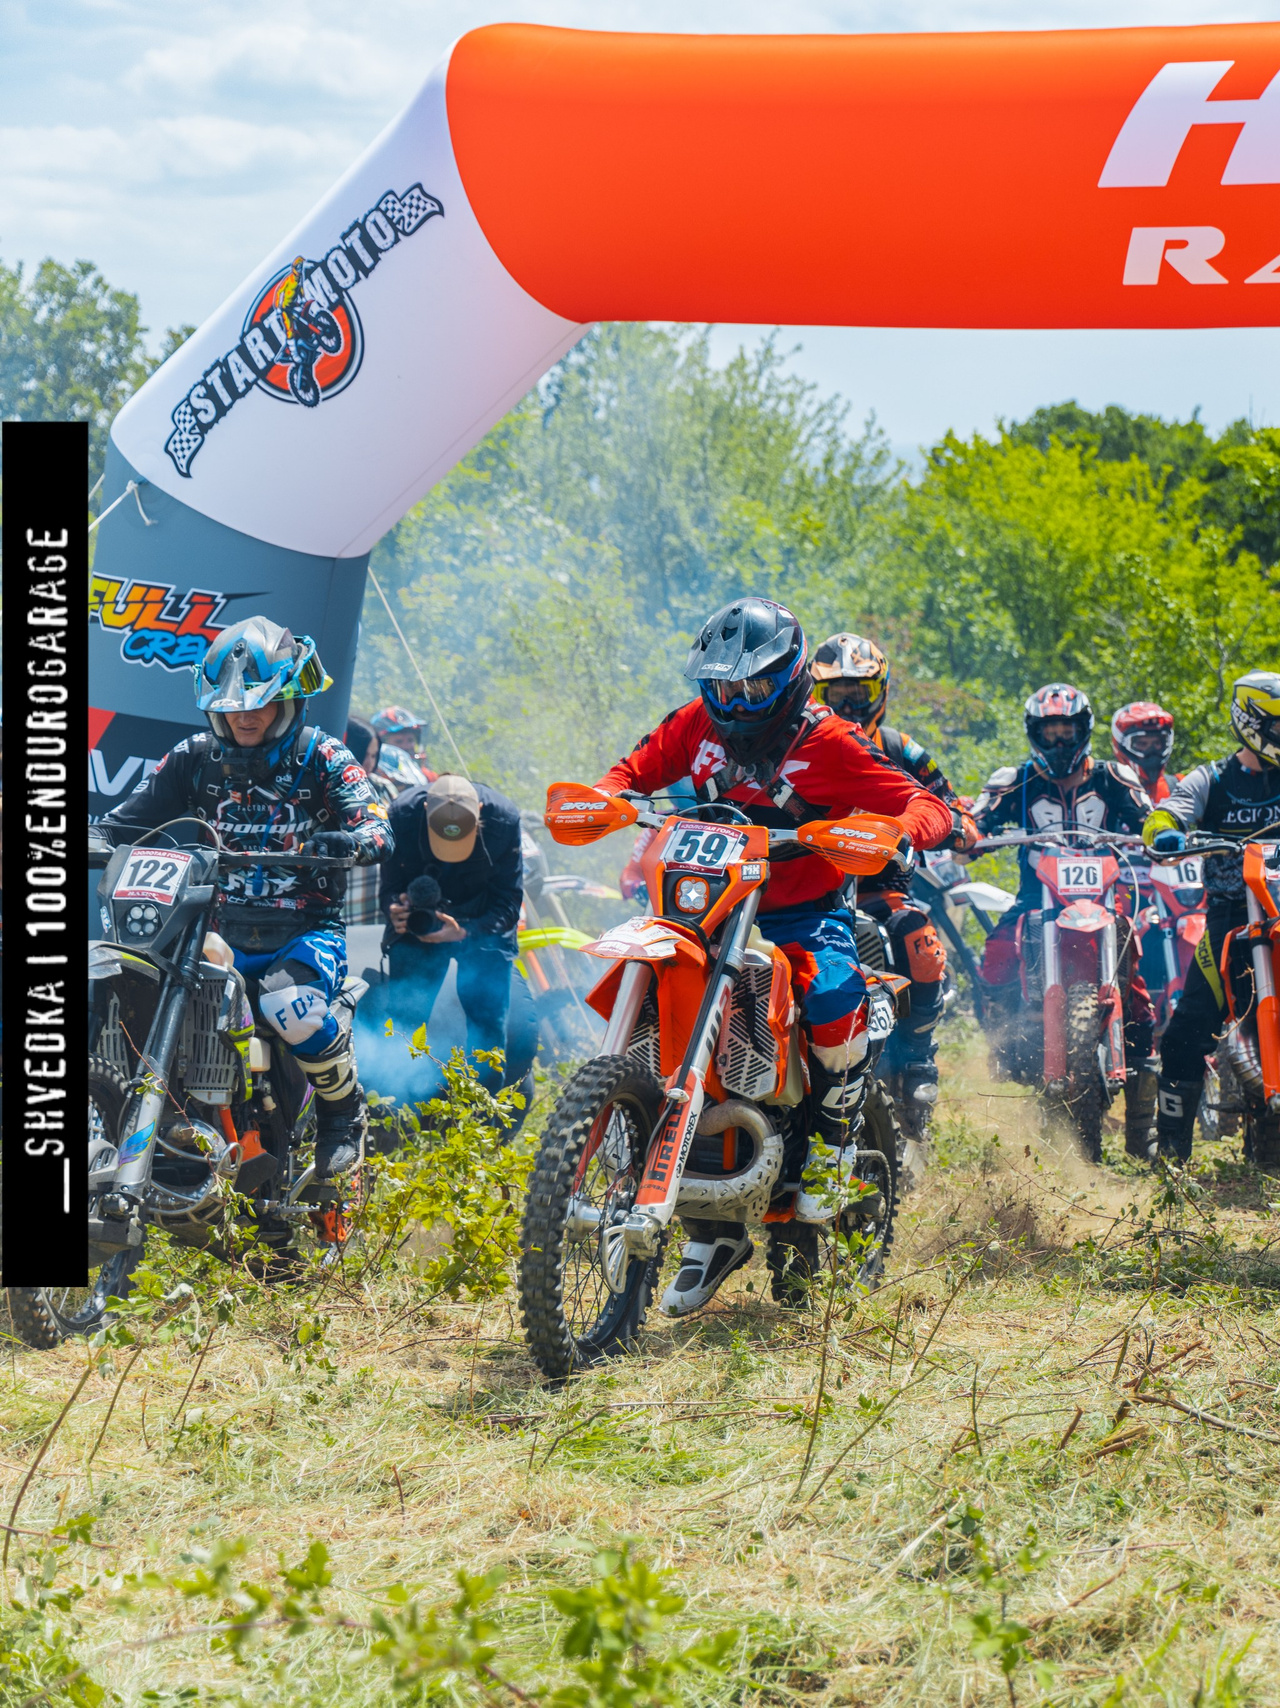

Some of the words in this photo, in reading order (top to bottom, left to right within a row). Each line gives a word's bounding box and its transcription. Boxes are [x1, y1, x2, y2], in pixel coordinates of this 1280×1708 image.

[189, 311, 287, 425] START
[303, 209, 398, 317] MOTO
[88, 574, 224, 641] FULL
[124, 628, 210, 665] CRE
[673, 830, 729, 867] 59
[127, 859, 179, 892] 122
[223, 873, 298, 897] FOX
[1061, 866, 1098, 886] 126
[646, 1102, 685, 1182] PIRELL
[678, 1111, 698, 1164] MOTOREX
